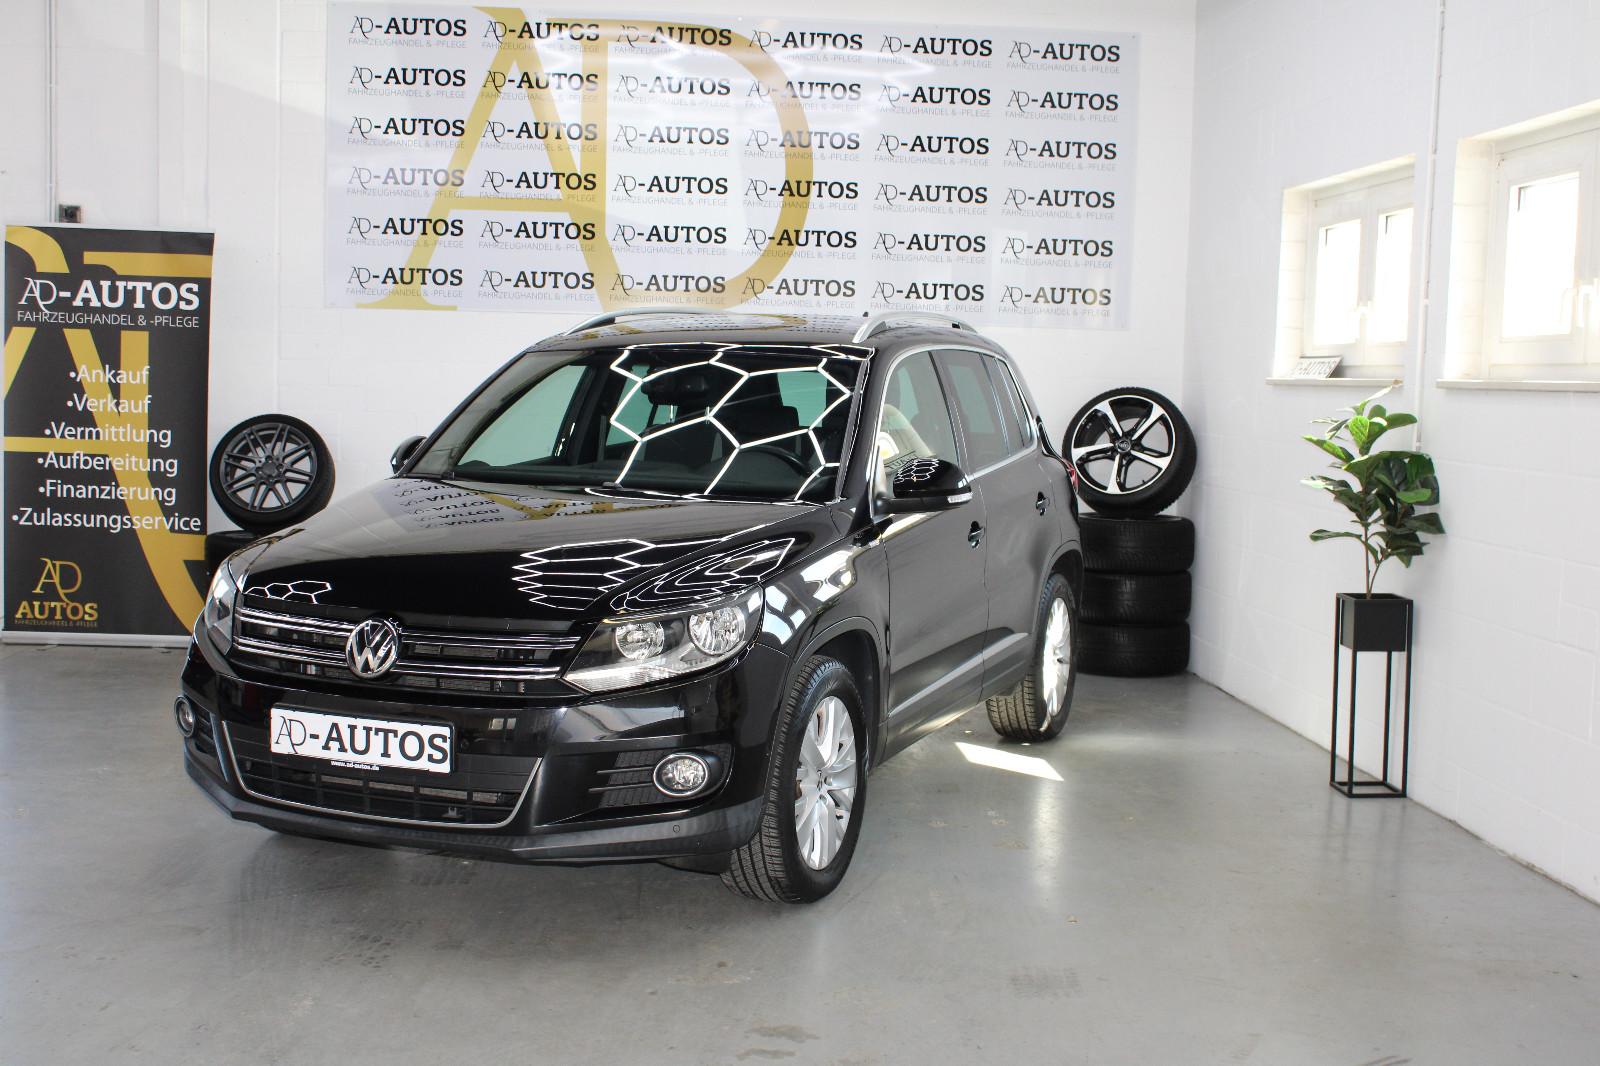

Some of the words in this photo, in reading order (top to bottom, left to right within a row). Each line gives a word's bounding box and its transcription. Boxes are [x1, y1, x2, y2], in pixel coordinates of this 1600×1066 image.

[17, 310, 134, 326] FAHRZEUGHANDEL
[137, 314, 147, 326] &
[150, 315, 199, 328] -PFLEGE
[76, 364, 150, 385] Ankauf
[73, 392, 153, 414] Verkauf
[50, 421, 172, 448] Vermittlung
[44, 451, 178, 477] Aufbereitung
[46, 479, 177, 506] Finanzierung
[19, 507, 201, 534] Zulassungsservice
[15, 600, 99, 621] AUTOS
